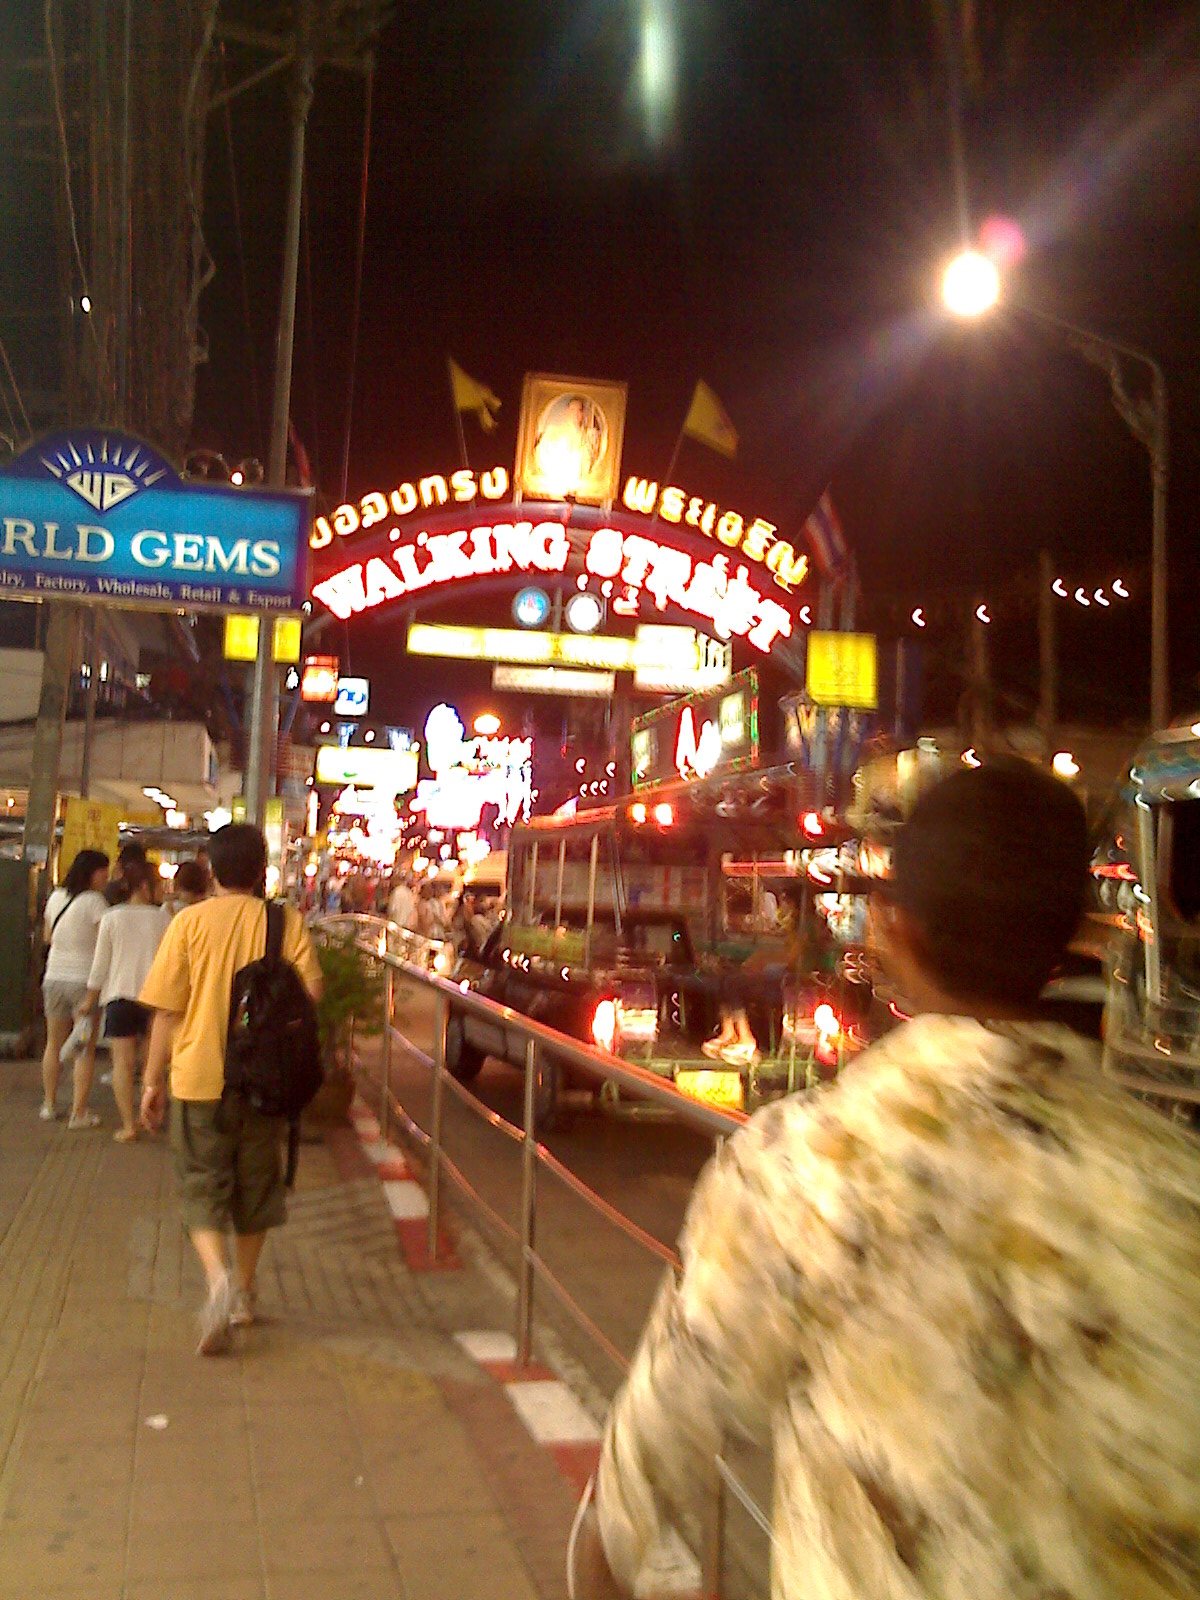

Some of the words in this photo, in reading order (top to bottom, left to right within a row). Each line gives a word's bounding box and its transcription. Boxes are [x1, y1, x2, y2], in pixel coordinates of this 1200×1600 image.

[131, 529, 281, 577] GEMS
[311, 522, 569, 619] WALKING
[35, 572, 90, 593] Factory,
[98, 576, 173, 600] Wholesale,
[181, 583, 220, 602] Retail
[228, 588, 240, 604] &
[247, 589, 291, 608] Export
